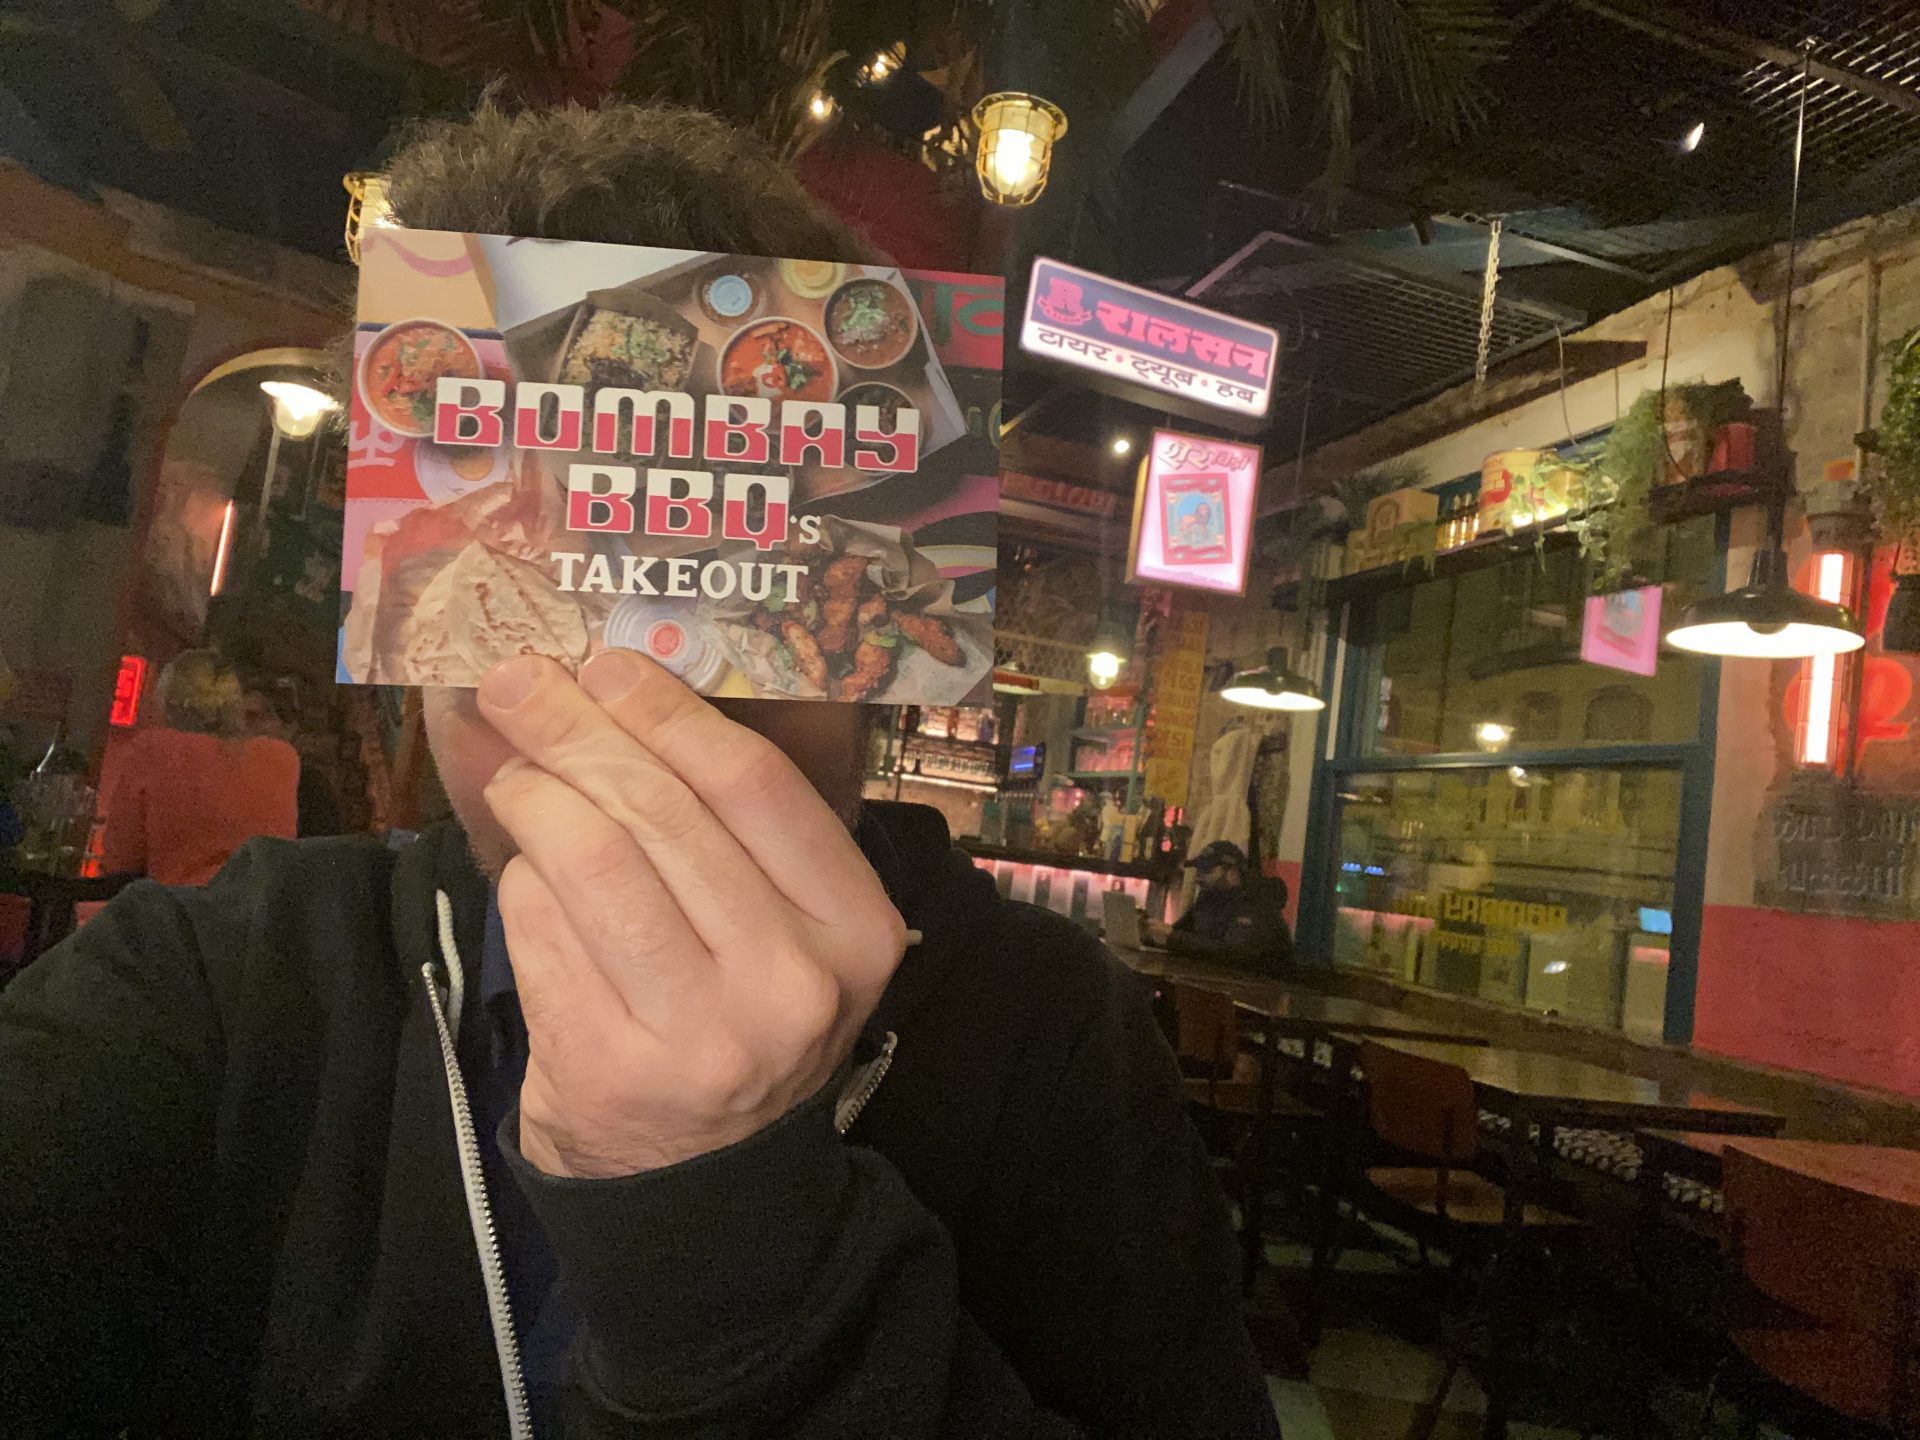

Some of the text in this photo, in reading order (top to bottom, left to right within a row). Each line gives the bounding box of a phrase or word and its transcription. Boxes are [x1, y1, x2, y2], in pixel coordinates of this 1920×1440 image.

[1037, 328, 1113, 362] टायर
[1216, 380, 1258, 404] हब
[1097, 300, 1268, 377] रालसन
[433, 377, 921, 473] BOMBAY
[550, 552, 809, 603] TAKEOUT
